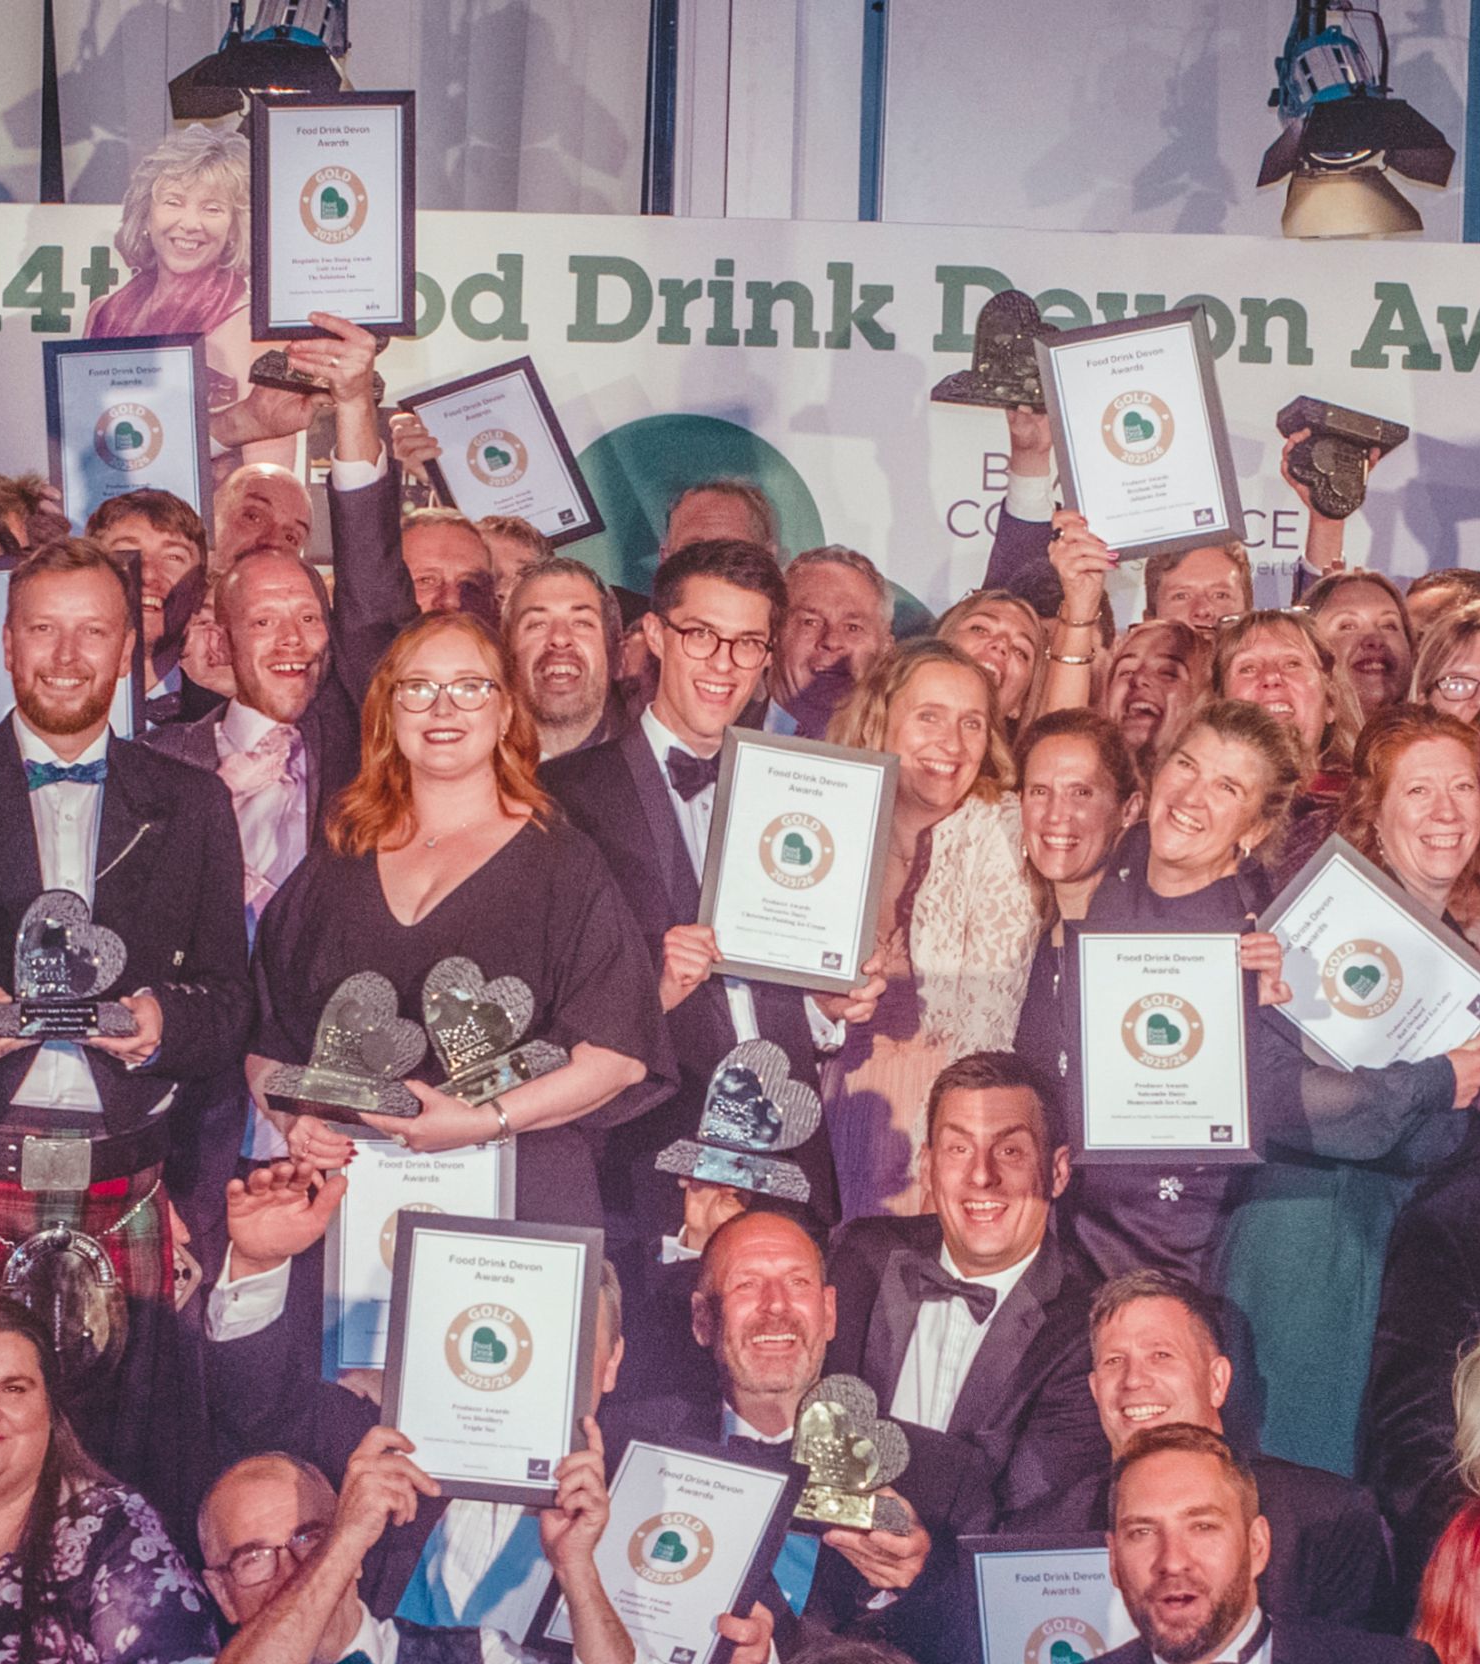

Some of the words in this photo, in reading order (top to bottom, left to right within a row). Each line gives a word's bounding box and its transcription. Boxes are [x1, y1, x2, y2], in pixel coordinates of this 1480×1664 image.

[296, 126, 317, 134] Food
[319, 126, 341, 134] Drink
[317, 138, 348, 147] Awards
[567, 255, 896, 350] Drink
[1085, 356, 1109, 368] Food
[1109, 351, 1134, 363] Drink
[1134, 346, 1164, 359] Devon
[1109, 362, 1144, 375] Awards
[1116, 953, 1142, 961] Food
[1143, 953, 1170, 961] Drink
[1172, 953, 1204, 961] Devon
[1141, 966, 1180, 974] Awards
[448, 1253, 476, 1265] Food
[477, 1256, 506, 1268] Drink
[508, 1259, 543, 1272] Devon
[474, 1271, 515, 1284] Awards
